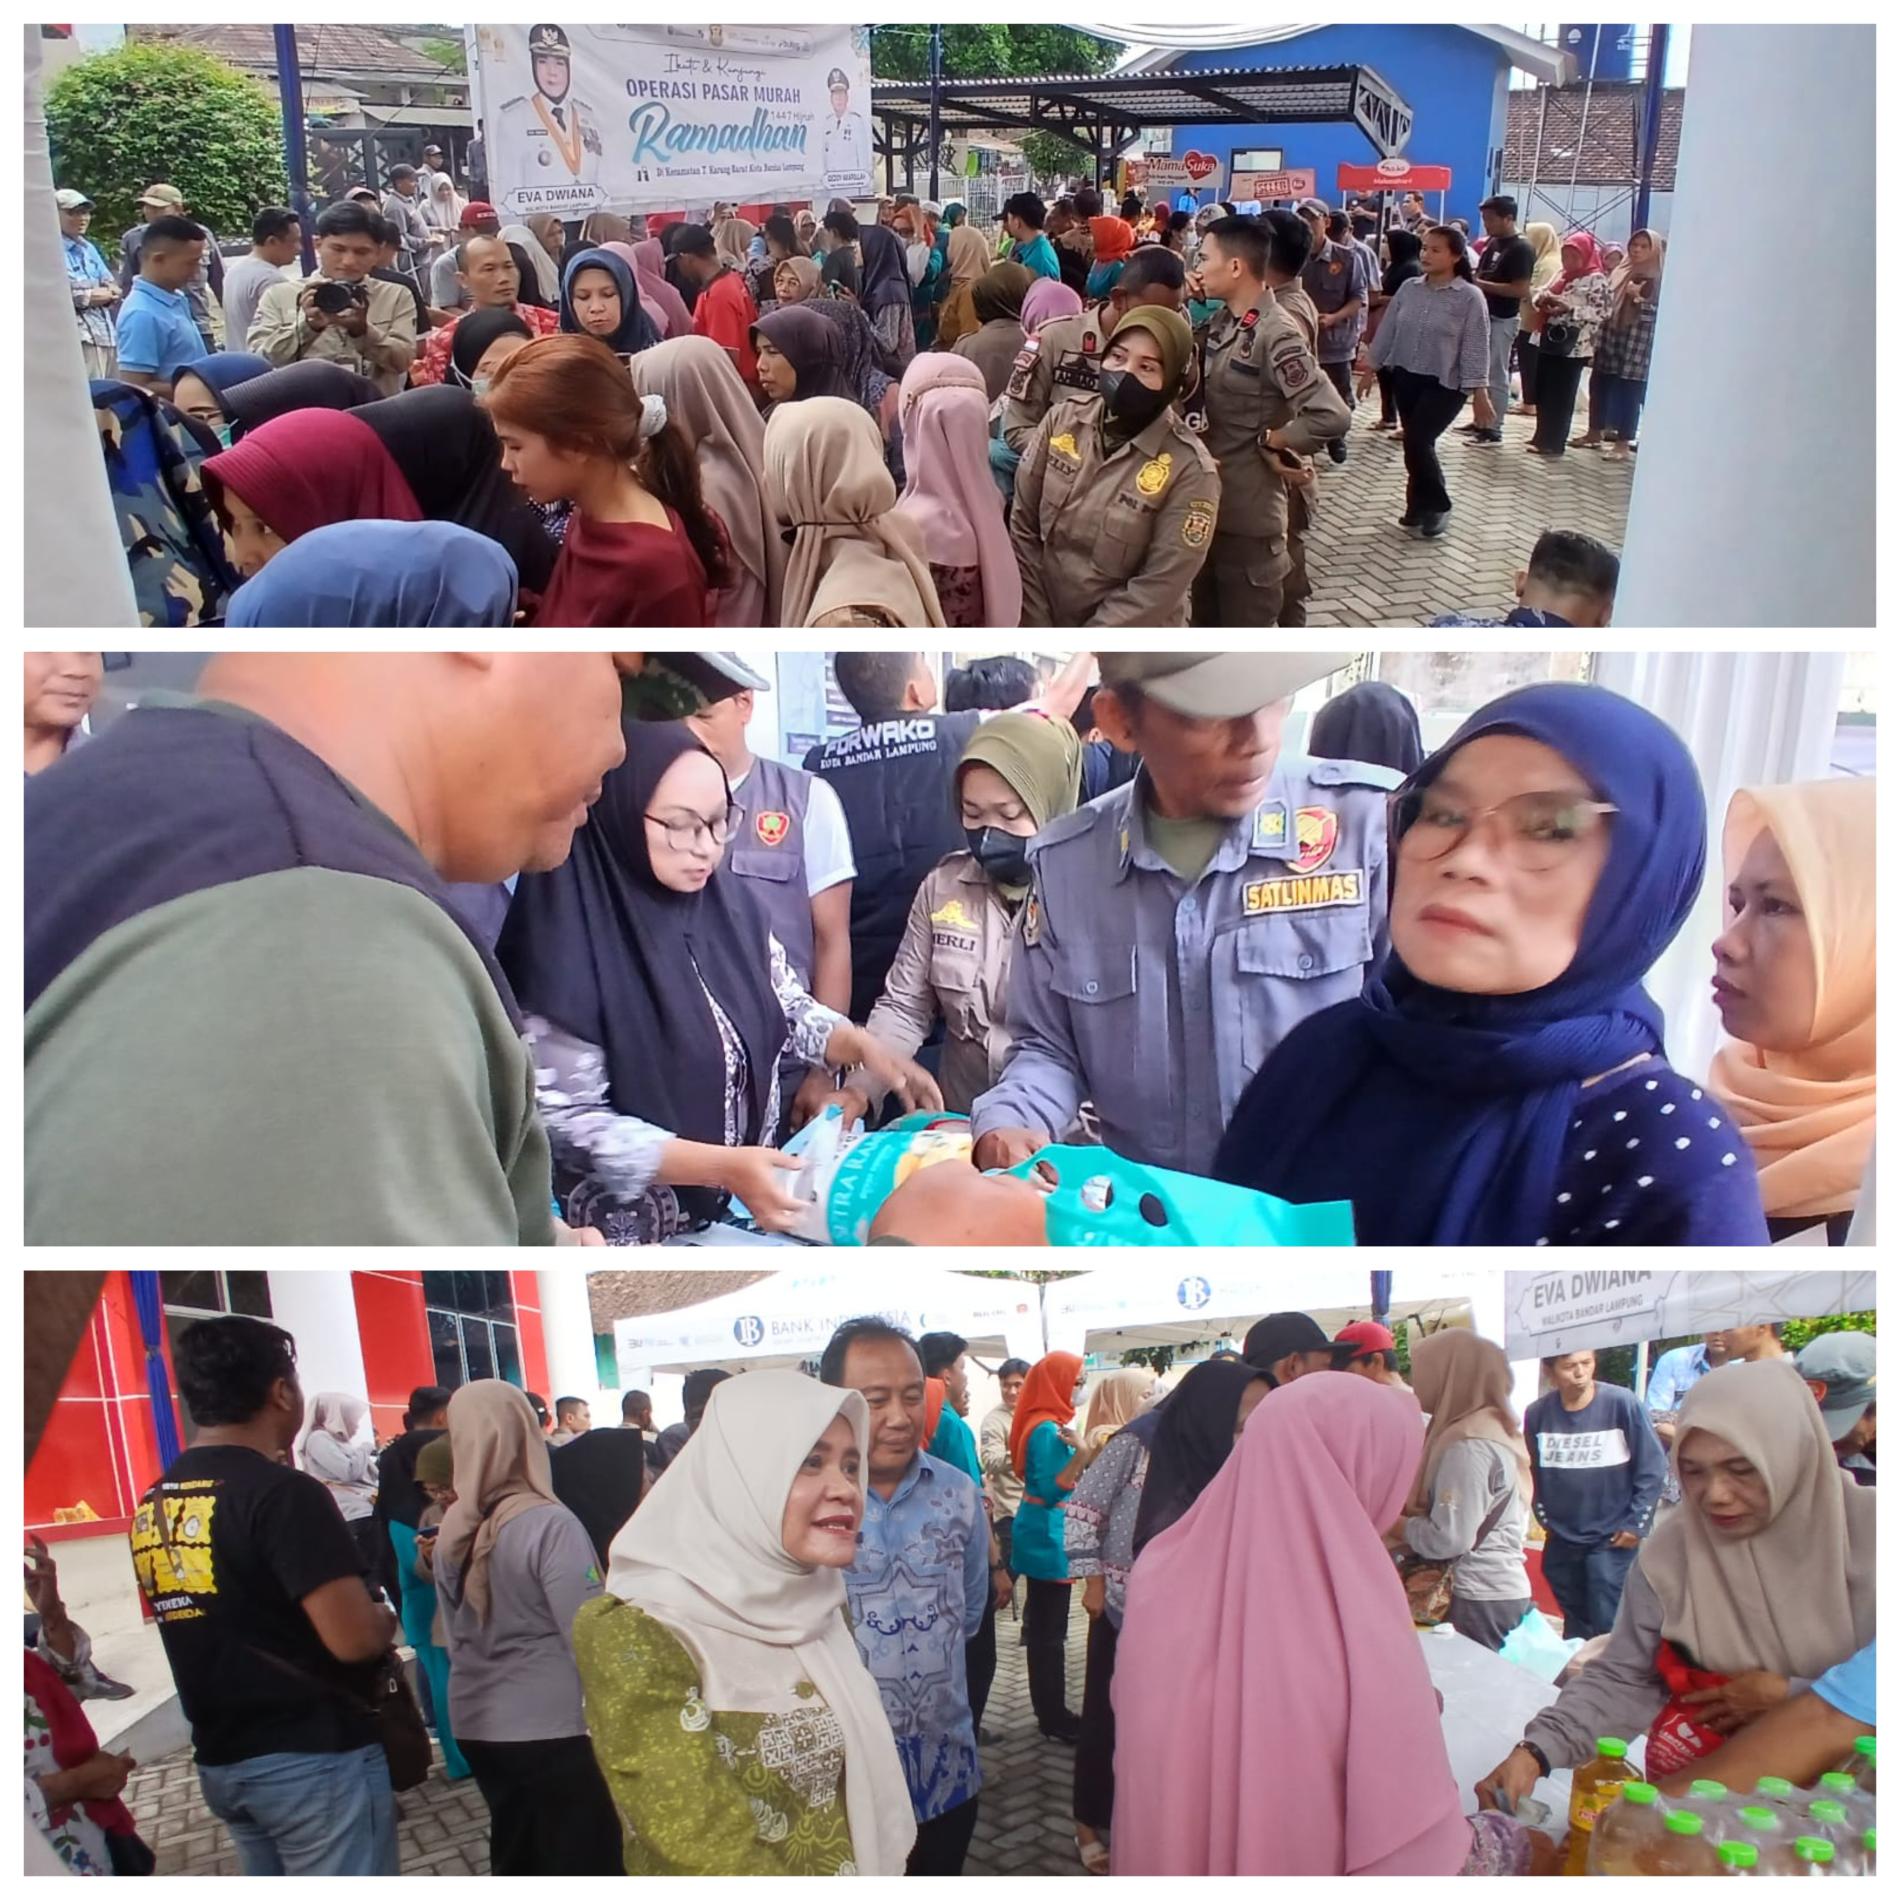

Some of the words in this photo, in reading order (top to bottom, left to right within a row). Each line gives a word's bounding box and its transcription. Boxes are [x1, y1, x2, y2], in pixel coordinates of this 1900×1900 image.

[716, 57, 767, 83] Kunjungi
[626, 79, 696, 99] OPERASI
[703, 86, 749, 102] PASAR
[754, 87, 800, 103] MURAH
[771, 110, 792, 121] 1447
[629, 101, 807, 164] Ramadhan
[1150, 158, 1185, 172] Mama
[1186, 158, 1216, 173] Suka
[518, 191, 542, 204] EVA
[546, 187, 595, 202] DWIANA
[824, 719, 936, 758] FORWAKO
[820, 756, 842, 770] KOTA
[845, 749, 882, 766] BANDAR
[886, 740, 937, 759] LAMPUNG
[1248, 875, 1358, 910] SATLINMAS
[1534, 1278, 1566, 1309] EVA
[1571, 1271, 1651, 1300] DWIANA
[1542, 1313, 1573, 1327] WALIKOTA
[1575, 1303, 1605, 1320] BANDAR
[1606, 1294, 1644, 1313] LAMPUNG
[771, 1319, 813, 1335] BANK
[1546, 1435, 1602, 1449] DIESEL
[1544, 1450, 1602, 1463] JEANS
